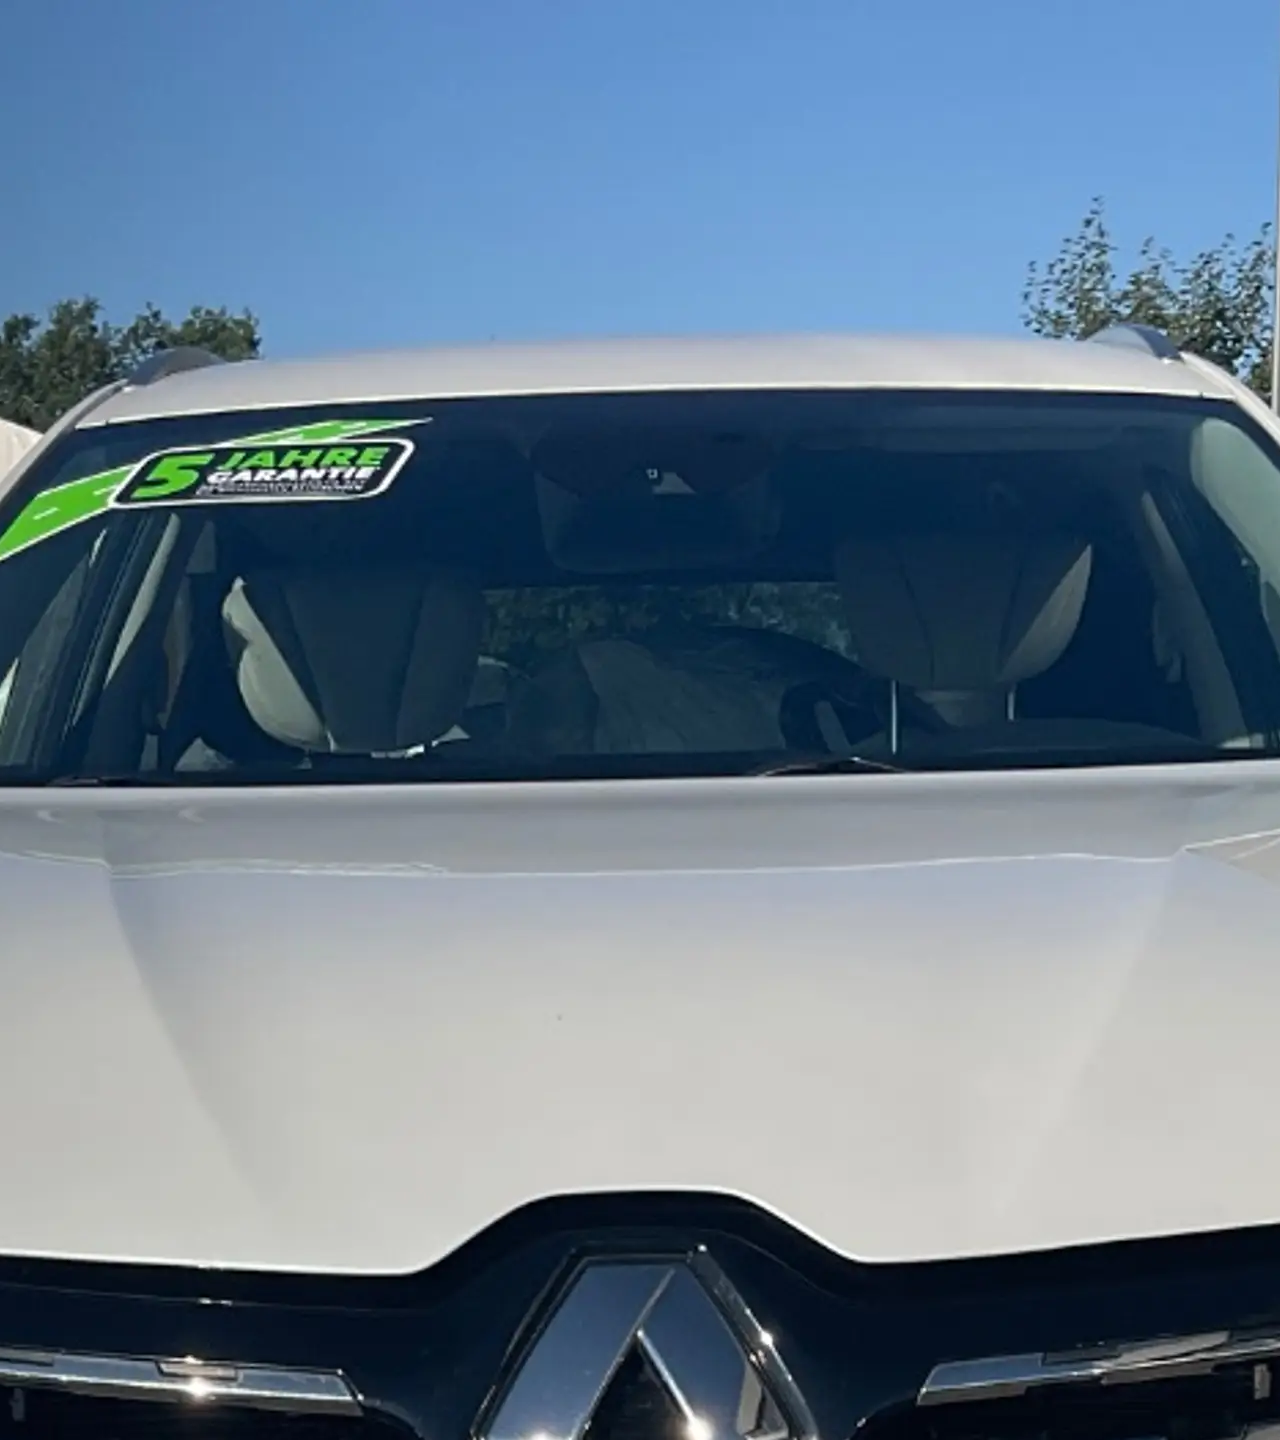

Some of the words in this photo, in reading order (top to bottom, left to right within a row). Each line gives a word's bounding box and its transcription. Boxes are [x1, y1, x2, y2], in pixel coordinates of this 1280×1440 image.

[216, 447, 391, 470] JAHRE
[130, 453, 215, 498] 5
[206, 466, 381, 484] GARANTIE
